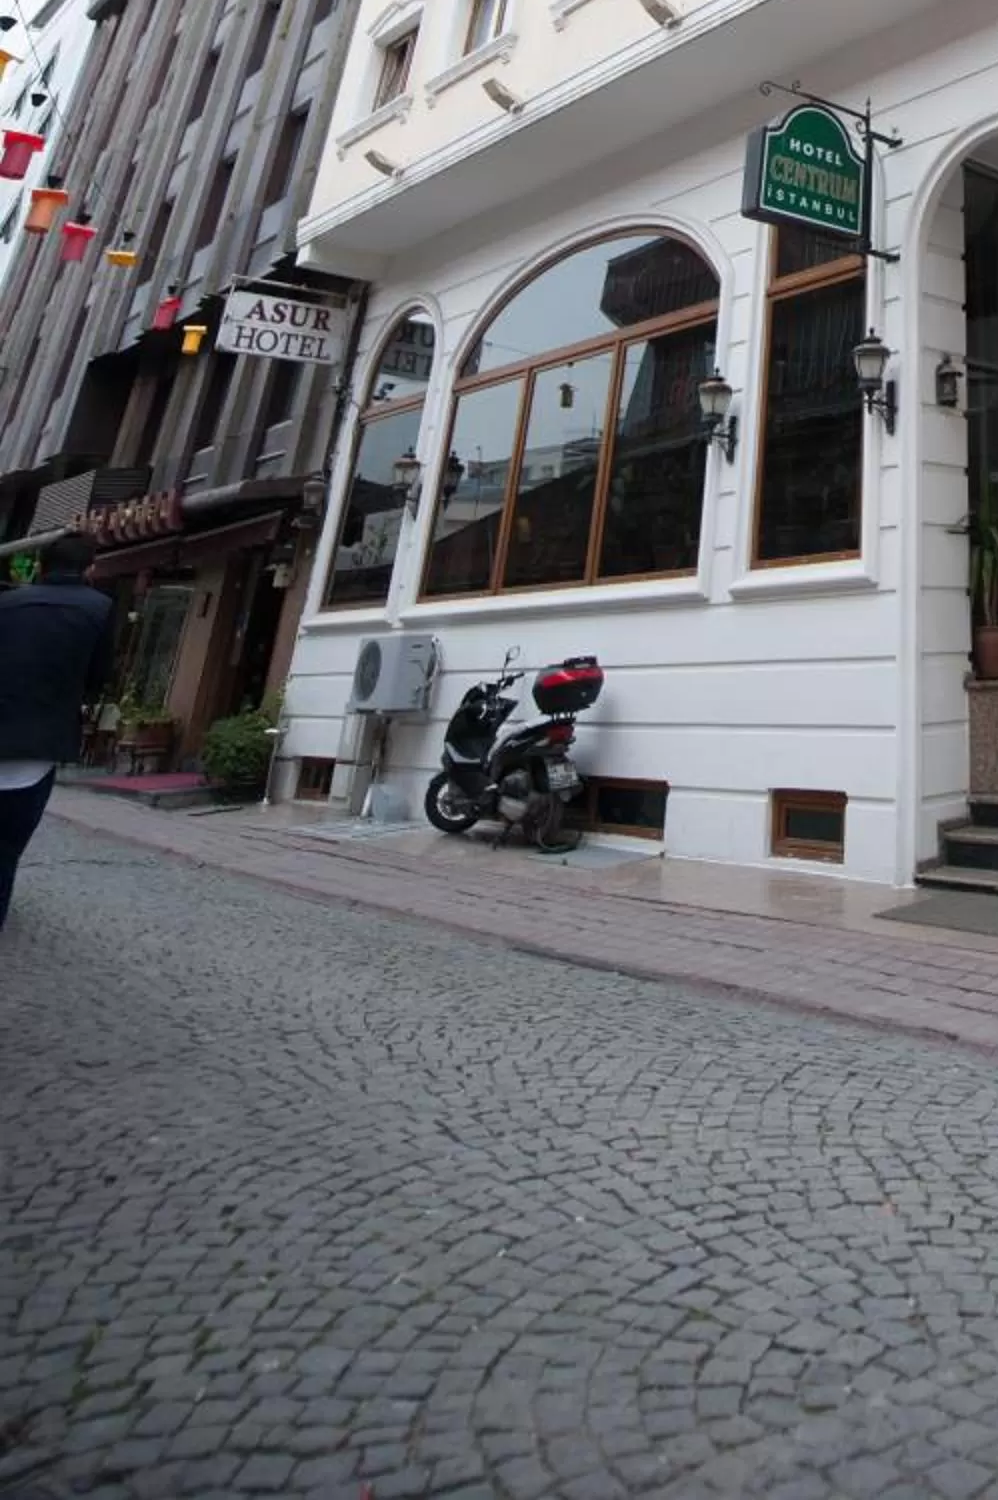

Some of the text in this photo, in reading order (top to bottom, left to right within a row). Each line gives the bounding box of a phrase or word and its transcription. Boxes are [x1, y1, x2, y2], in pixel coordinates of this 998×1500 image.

[788, 138, 844, 167] HOTEL
[769, 154, 859, 205] CENTRUM
[246, 298, 331, 332] ASUR
[233, 326, 330, 361] HOTEL
